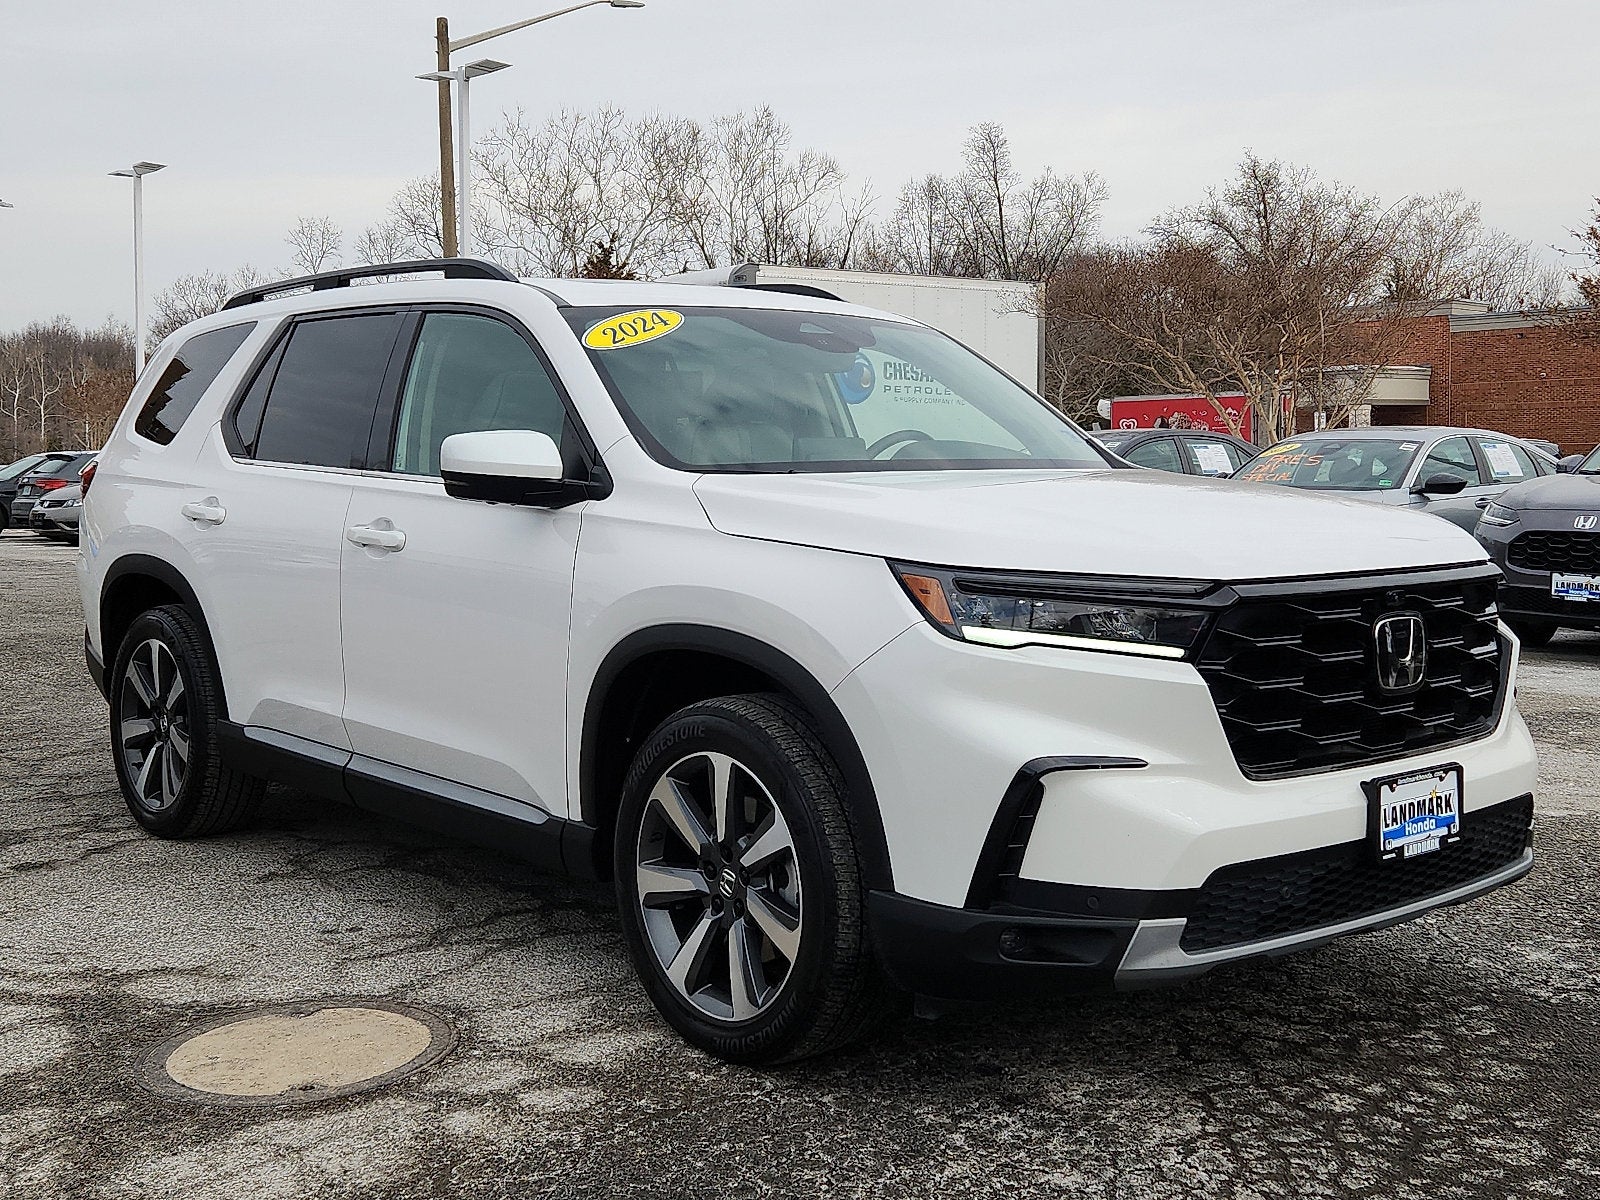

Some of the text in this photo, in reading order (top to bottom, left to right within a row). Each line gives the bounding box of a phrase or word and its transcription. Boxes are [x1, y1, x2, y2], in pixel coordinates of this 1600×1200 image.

[602, 312, 670, 344] 2024
[883, 385, 951, 395] PETROLE
[1555, 582, 1600, 592] LANDMARK
[1383, 793, 1453, 828] LANDMARK
[1405, 818, 1436, 836] Honda
[1404, 838, 1440, 857] LANDMARK
